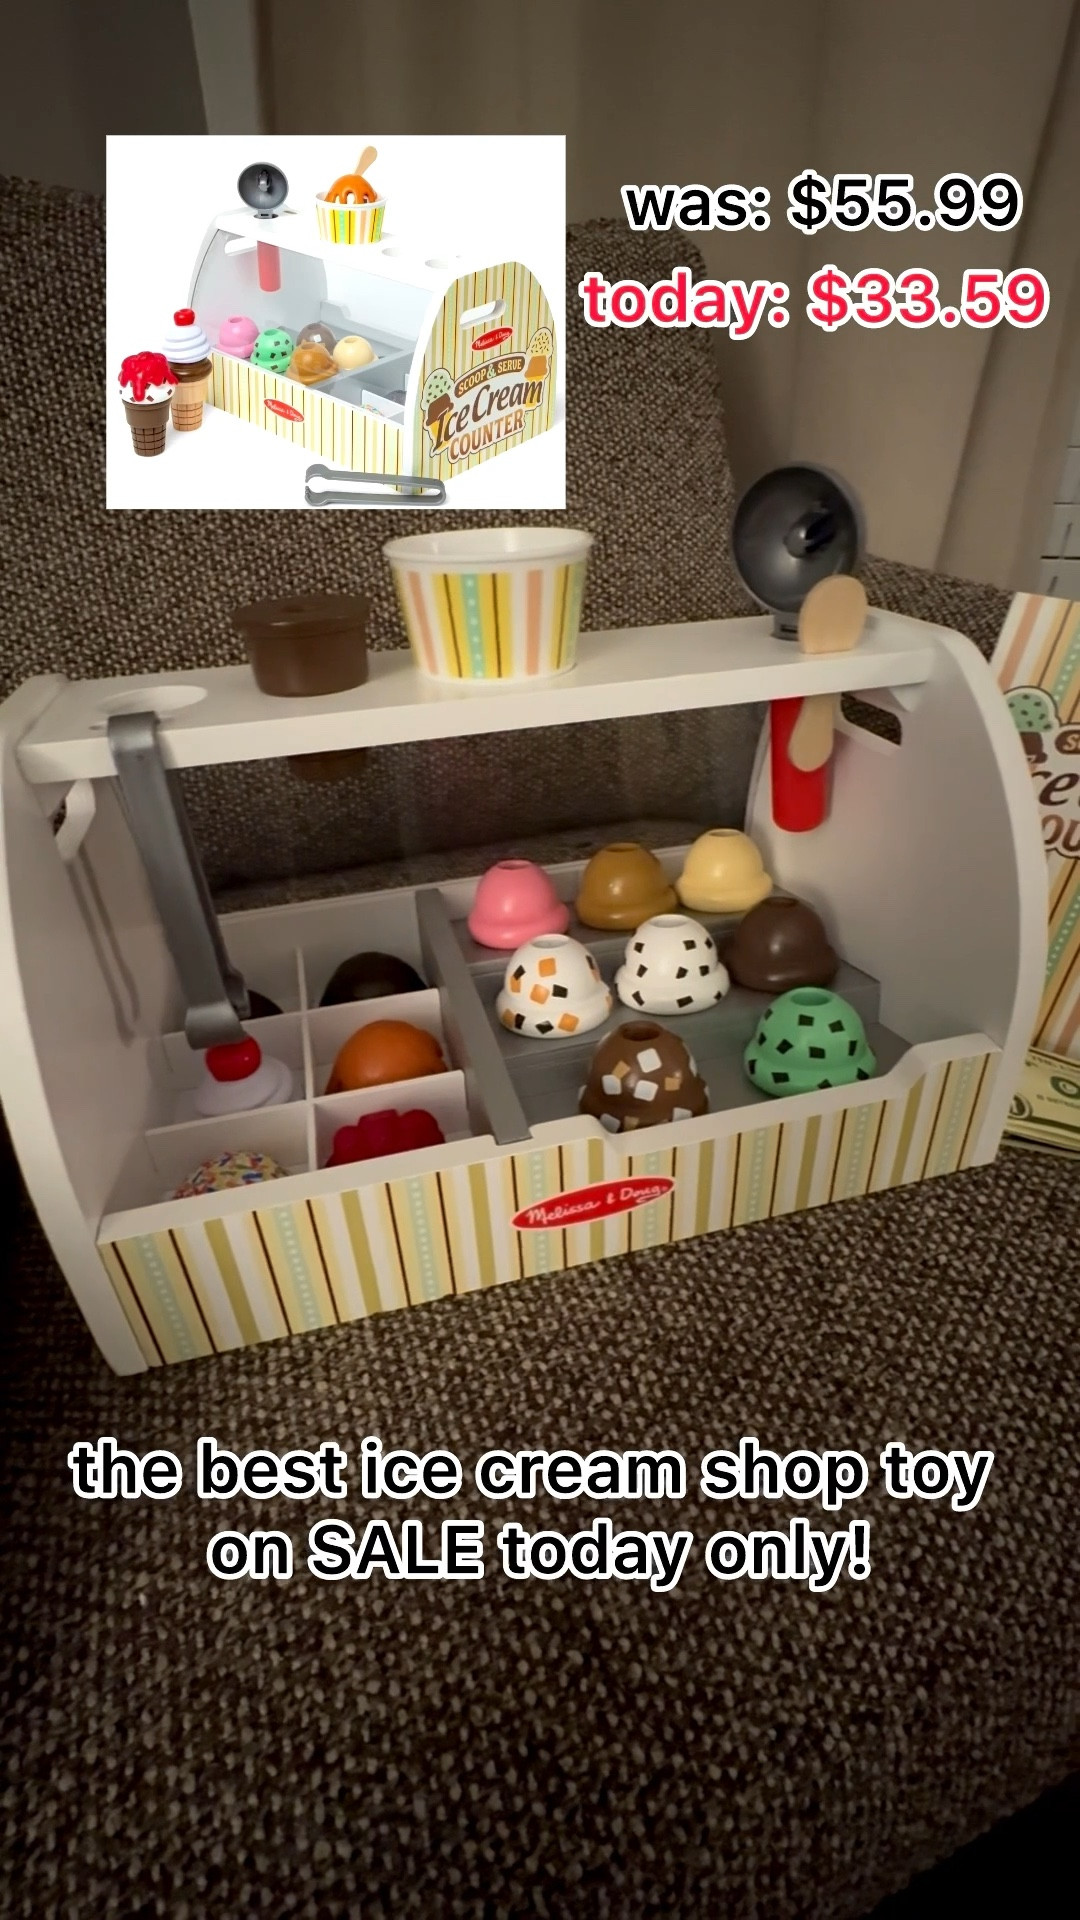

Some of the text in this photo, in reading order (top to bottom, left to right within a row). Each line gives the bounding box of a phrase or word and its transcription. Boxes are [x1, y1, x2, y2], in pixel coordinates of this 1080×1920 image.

[458, 358, 523, 396] SCOOP & SERVE
[432, 379, 543, 453] Ice Cream
[449, 410, 525, 461] COUNTER
[526, 1200, 602, 1225] Melissa
